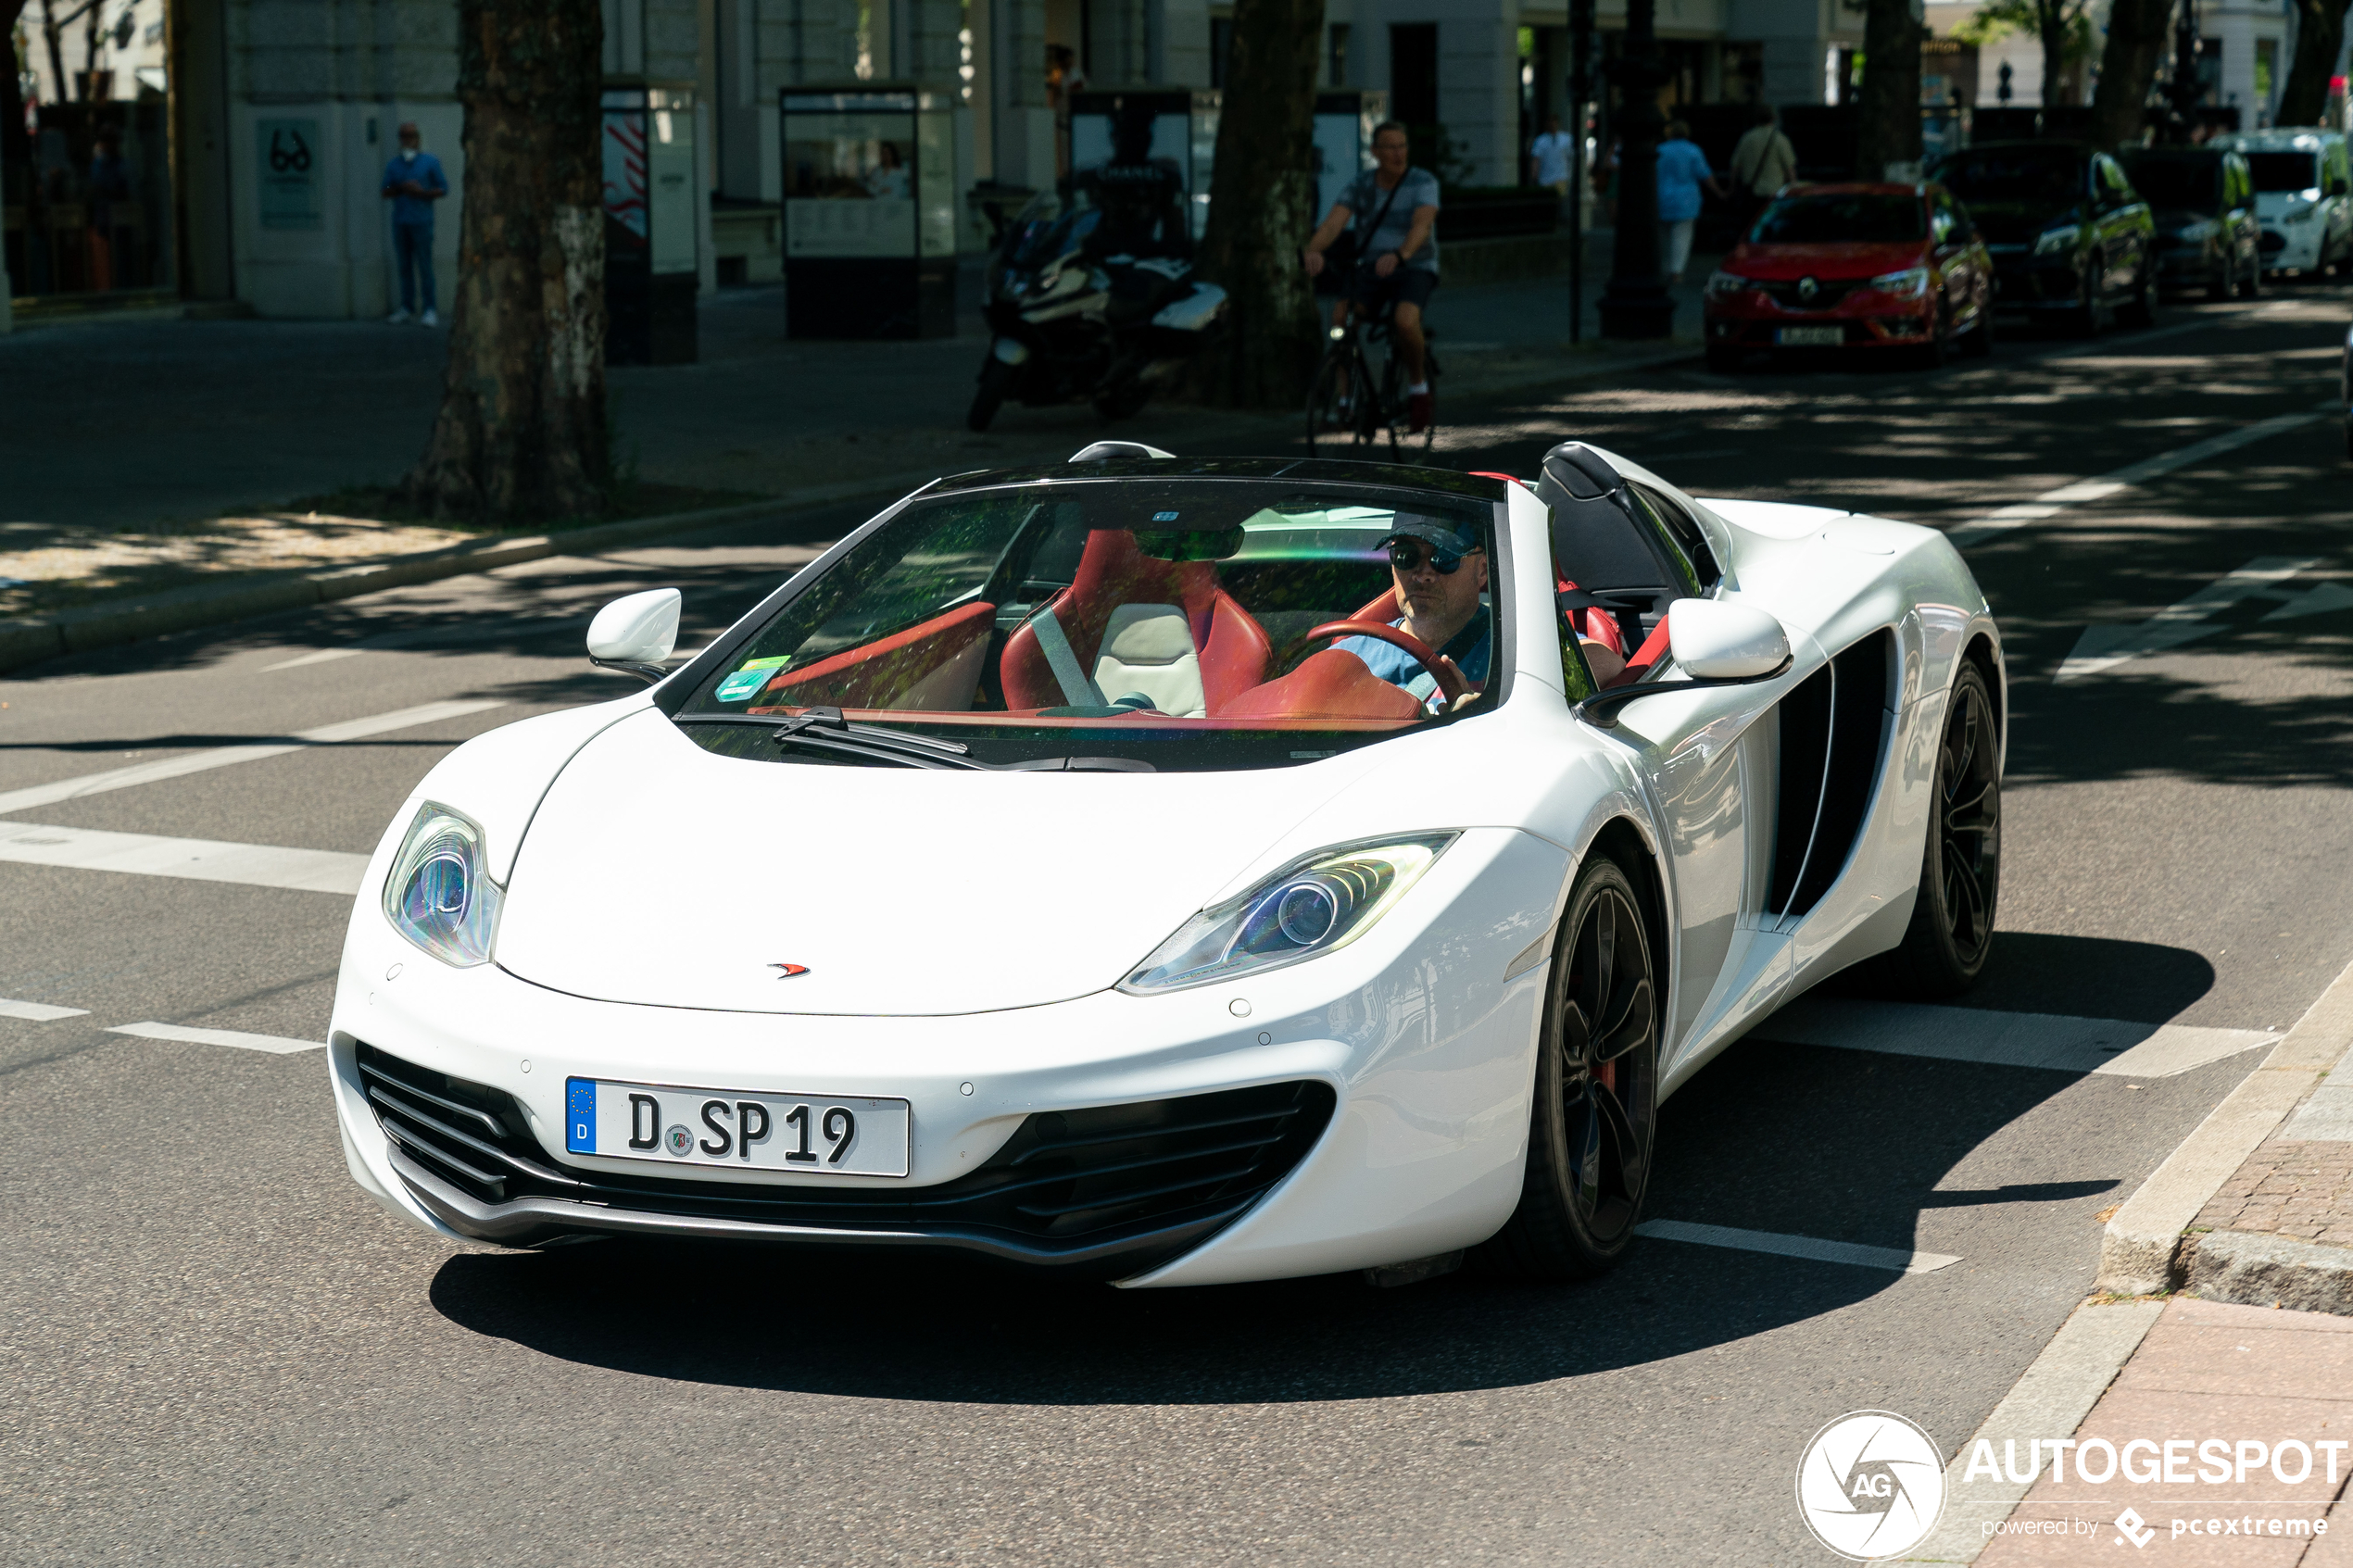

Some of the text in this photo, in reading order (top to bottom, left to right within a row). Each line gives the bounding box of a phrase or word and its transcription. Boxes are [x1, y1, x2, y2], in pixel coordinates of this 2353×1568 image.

[576, 1123, 587, 1139] D
[628, 1093, 659, 1149] D
[699, 1099, 770, 1158] SP
[786, 1105, 854, 1163] 19
